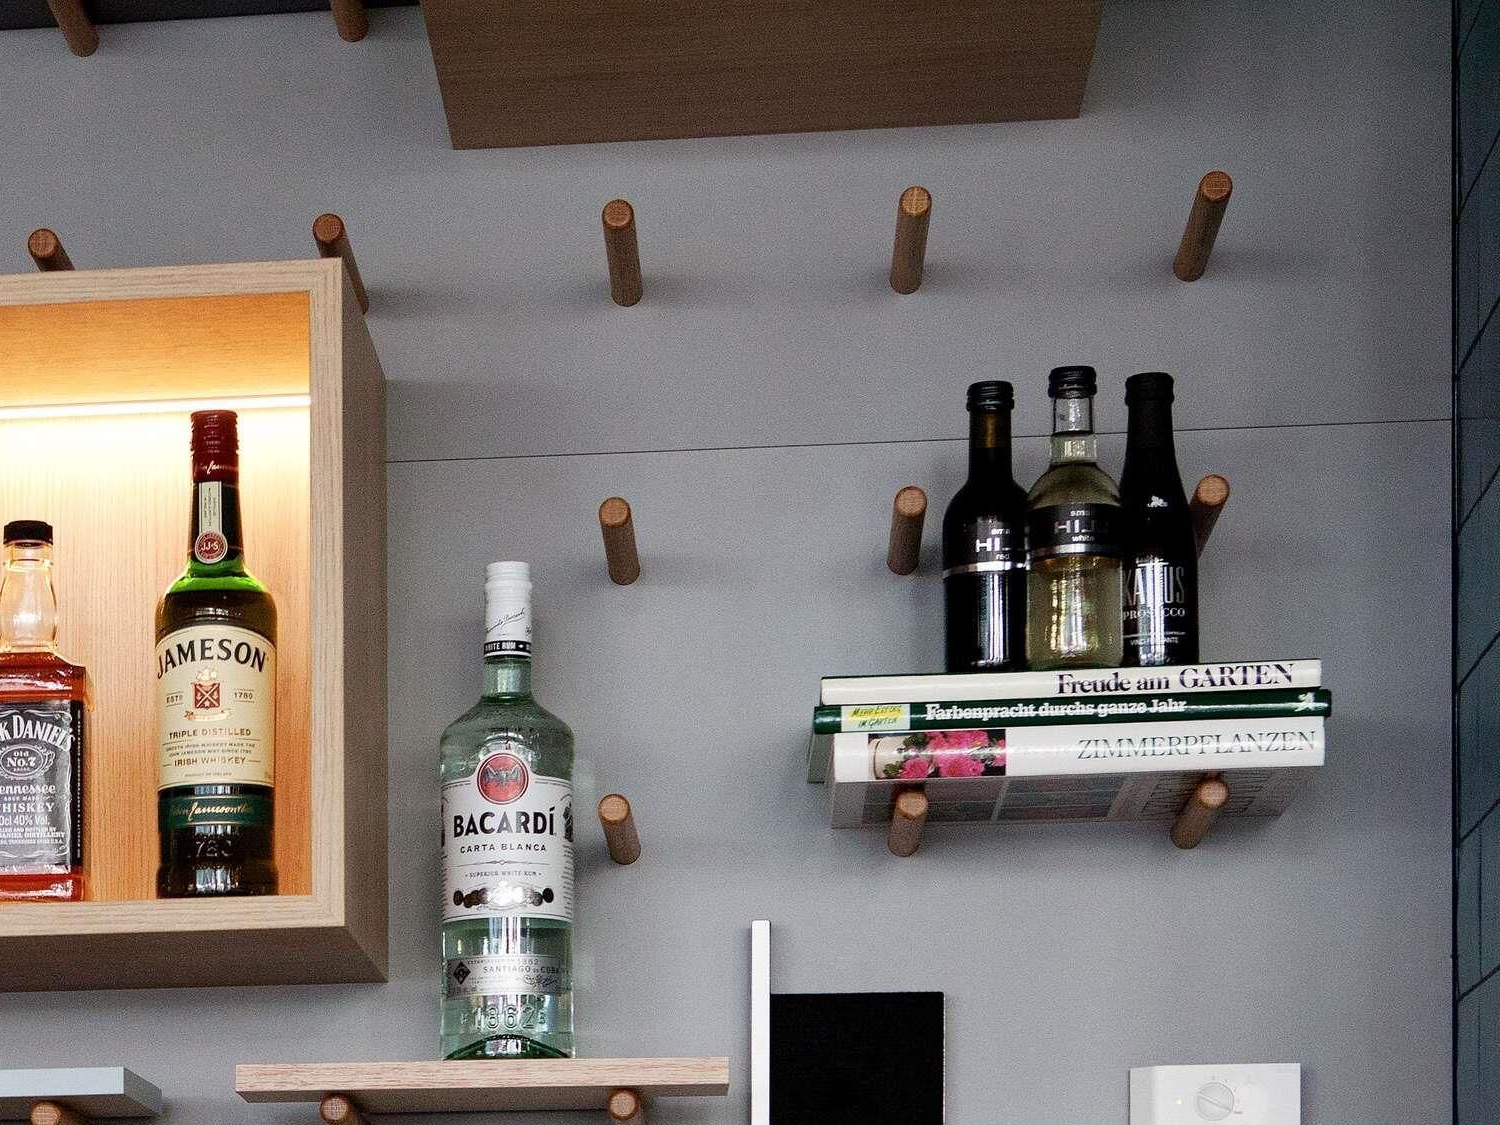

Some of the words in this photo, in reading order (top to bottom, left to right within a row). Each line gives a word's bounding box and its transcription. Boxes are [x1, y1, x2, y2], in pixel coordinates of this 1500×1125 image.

[1123, 607, 1186, 619] PROSCCO
[157, 638, 267, 679] JAMESON
[1057, 672, 1131, 694] Freude
[1136, 676, 1170, 691] am
[1179, 663, 1295, 688] GARTEN
[234, 692, 254, 700] 1780
[925, 703, 1042, 722] Farbenpracht
[1042, 701, 1096, 717] durchs
[1097, 700, 1147, 717] ganze
[1149, 698, 1187, 713] Jahr
[11, 715, 76, 751] DANIEL'S
[169, 729, 198, 740] TRIPLE
[201, 727, 251, 737] DISTILLED
[1077, 730, 1317, 760] ZIMMERPFLANZEN
[6, 757, 37, 768] No.7
[174, 757, 198, 767] IRISH
[201, 756, 246, 766] WHISKEY
[13, 815, 33, 826] 40%
[453, 806, 556, 839] BACARDÍ
[460, 843, 496, 854] CARTA
[501, 843, 547, 852] BLANCA
